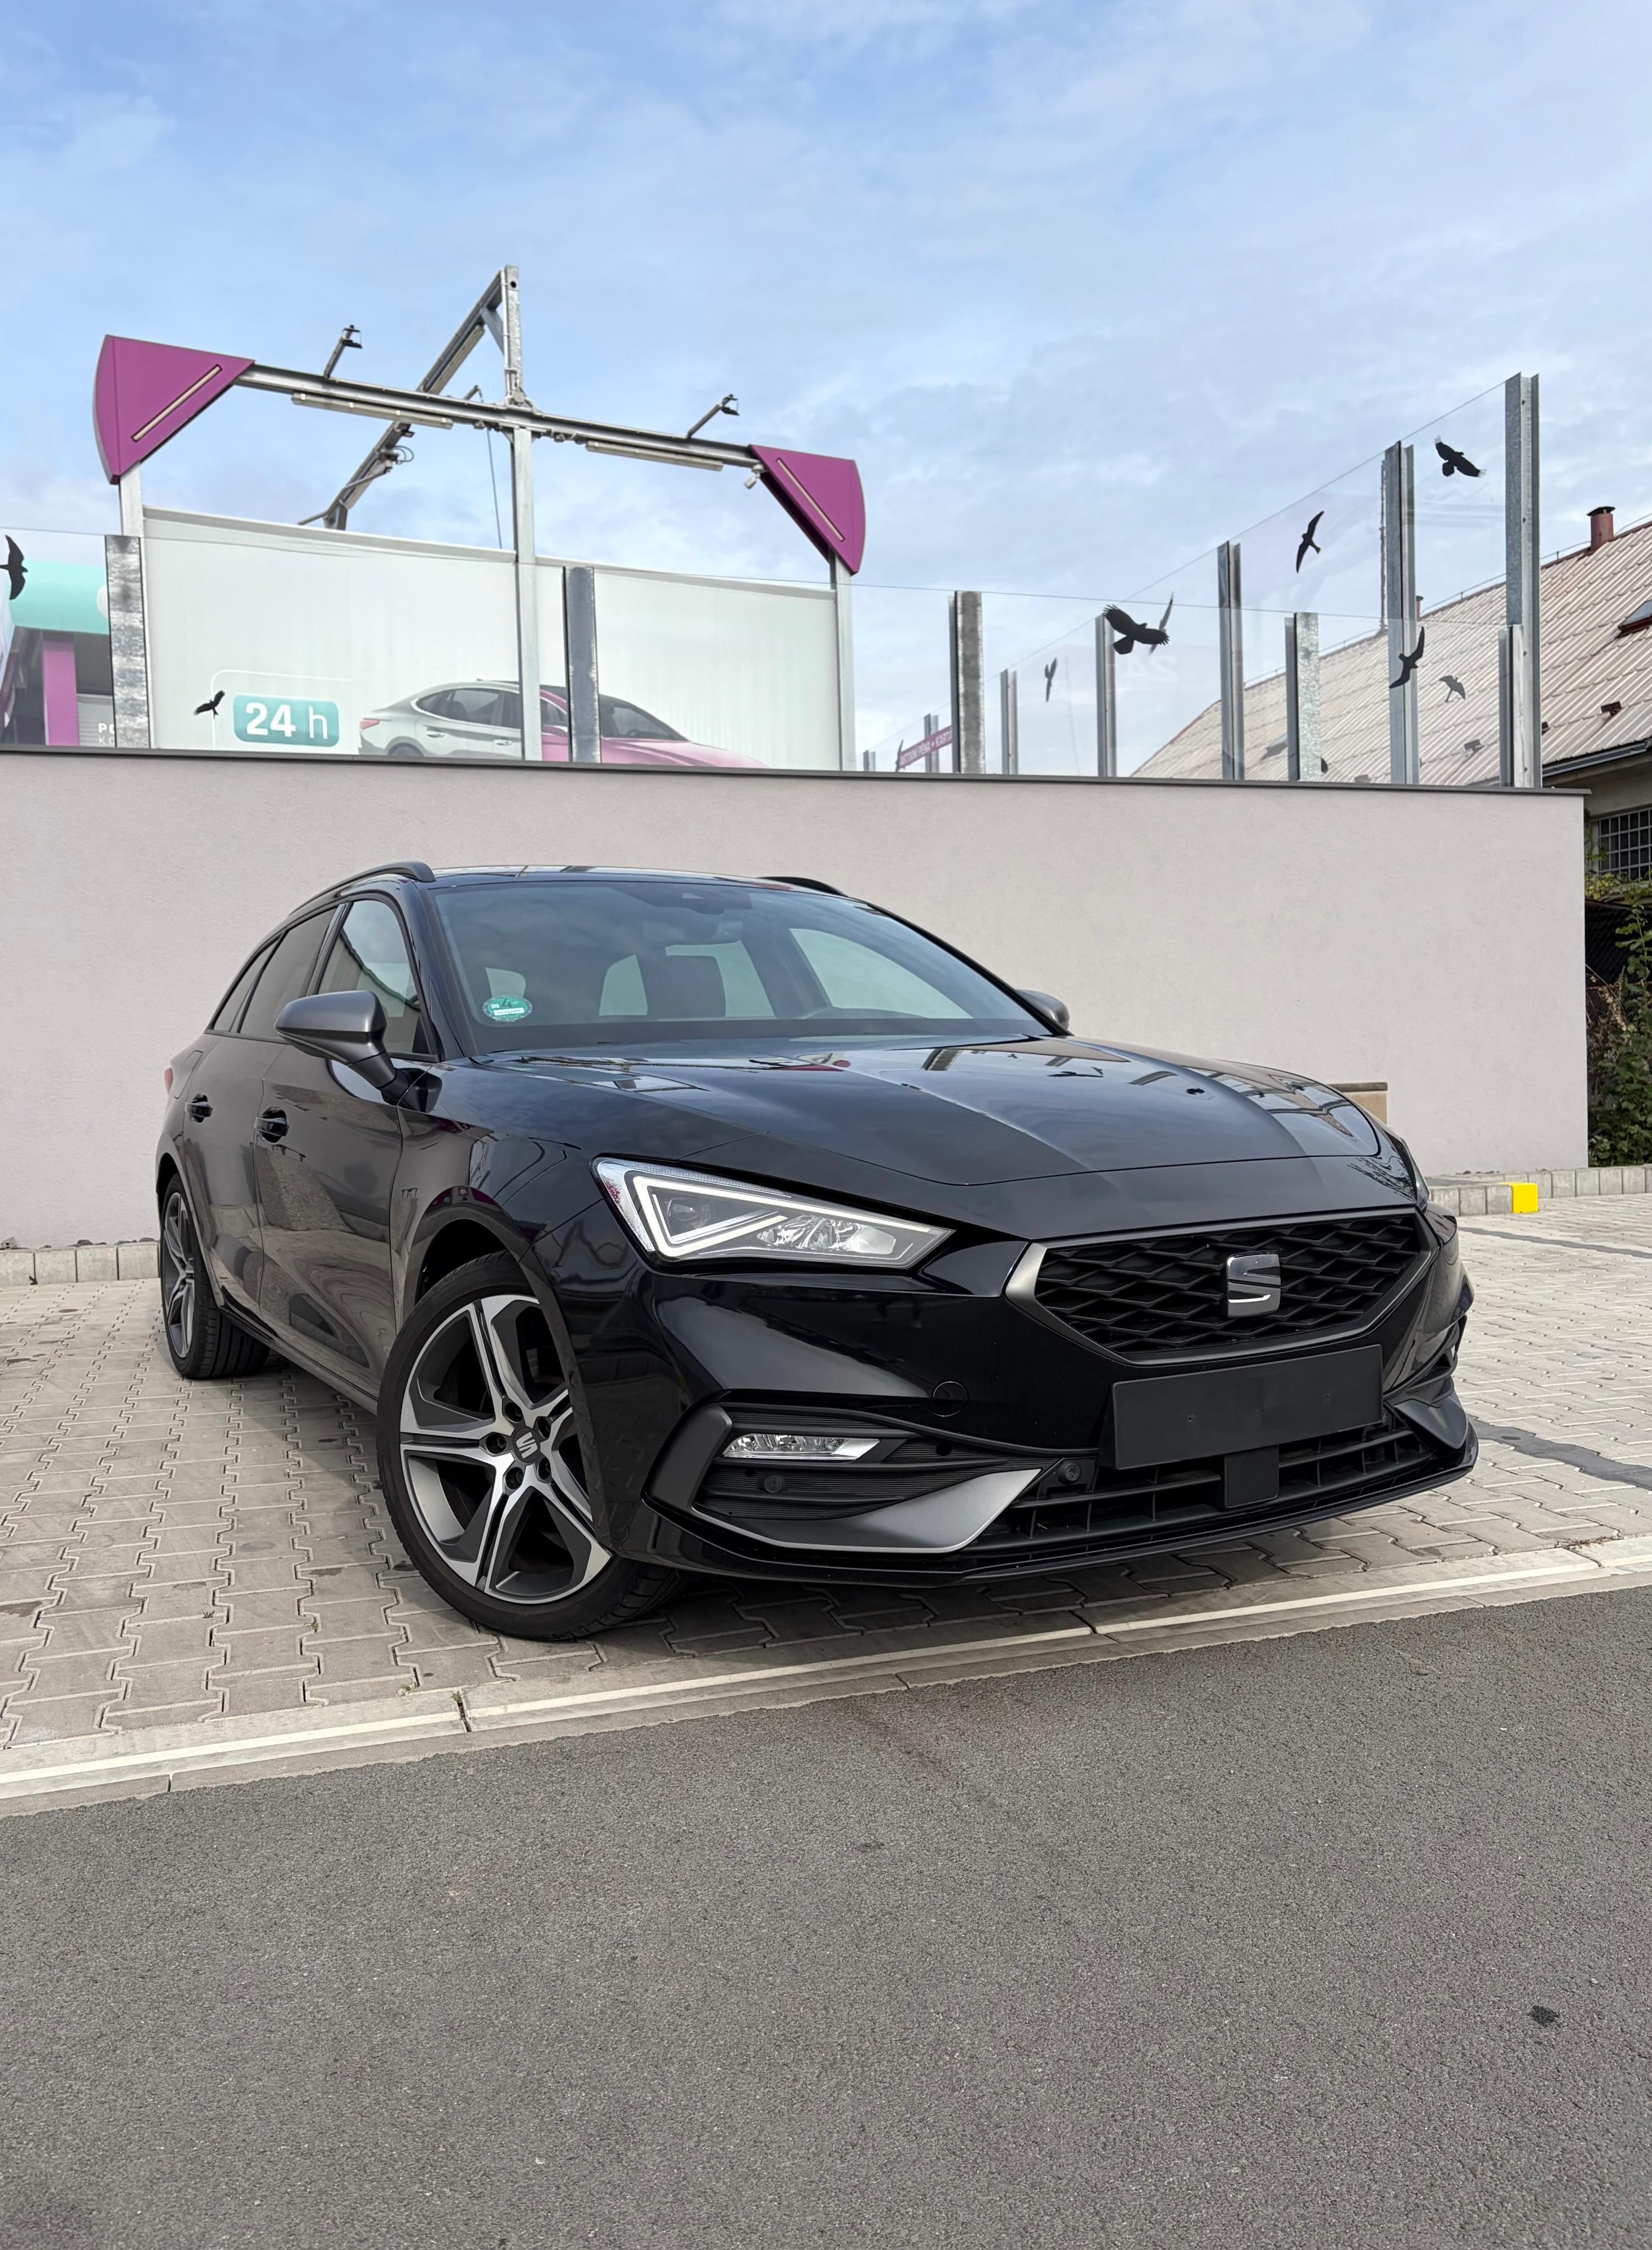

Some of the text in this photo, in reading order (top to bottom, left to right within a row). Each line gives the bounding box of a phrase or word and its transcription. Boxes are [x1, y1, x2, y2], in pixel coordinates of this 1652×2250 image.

[246, 701, 327, 739] 24 h
[501, 999, 513, 1008] 4
